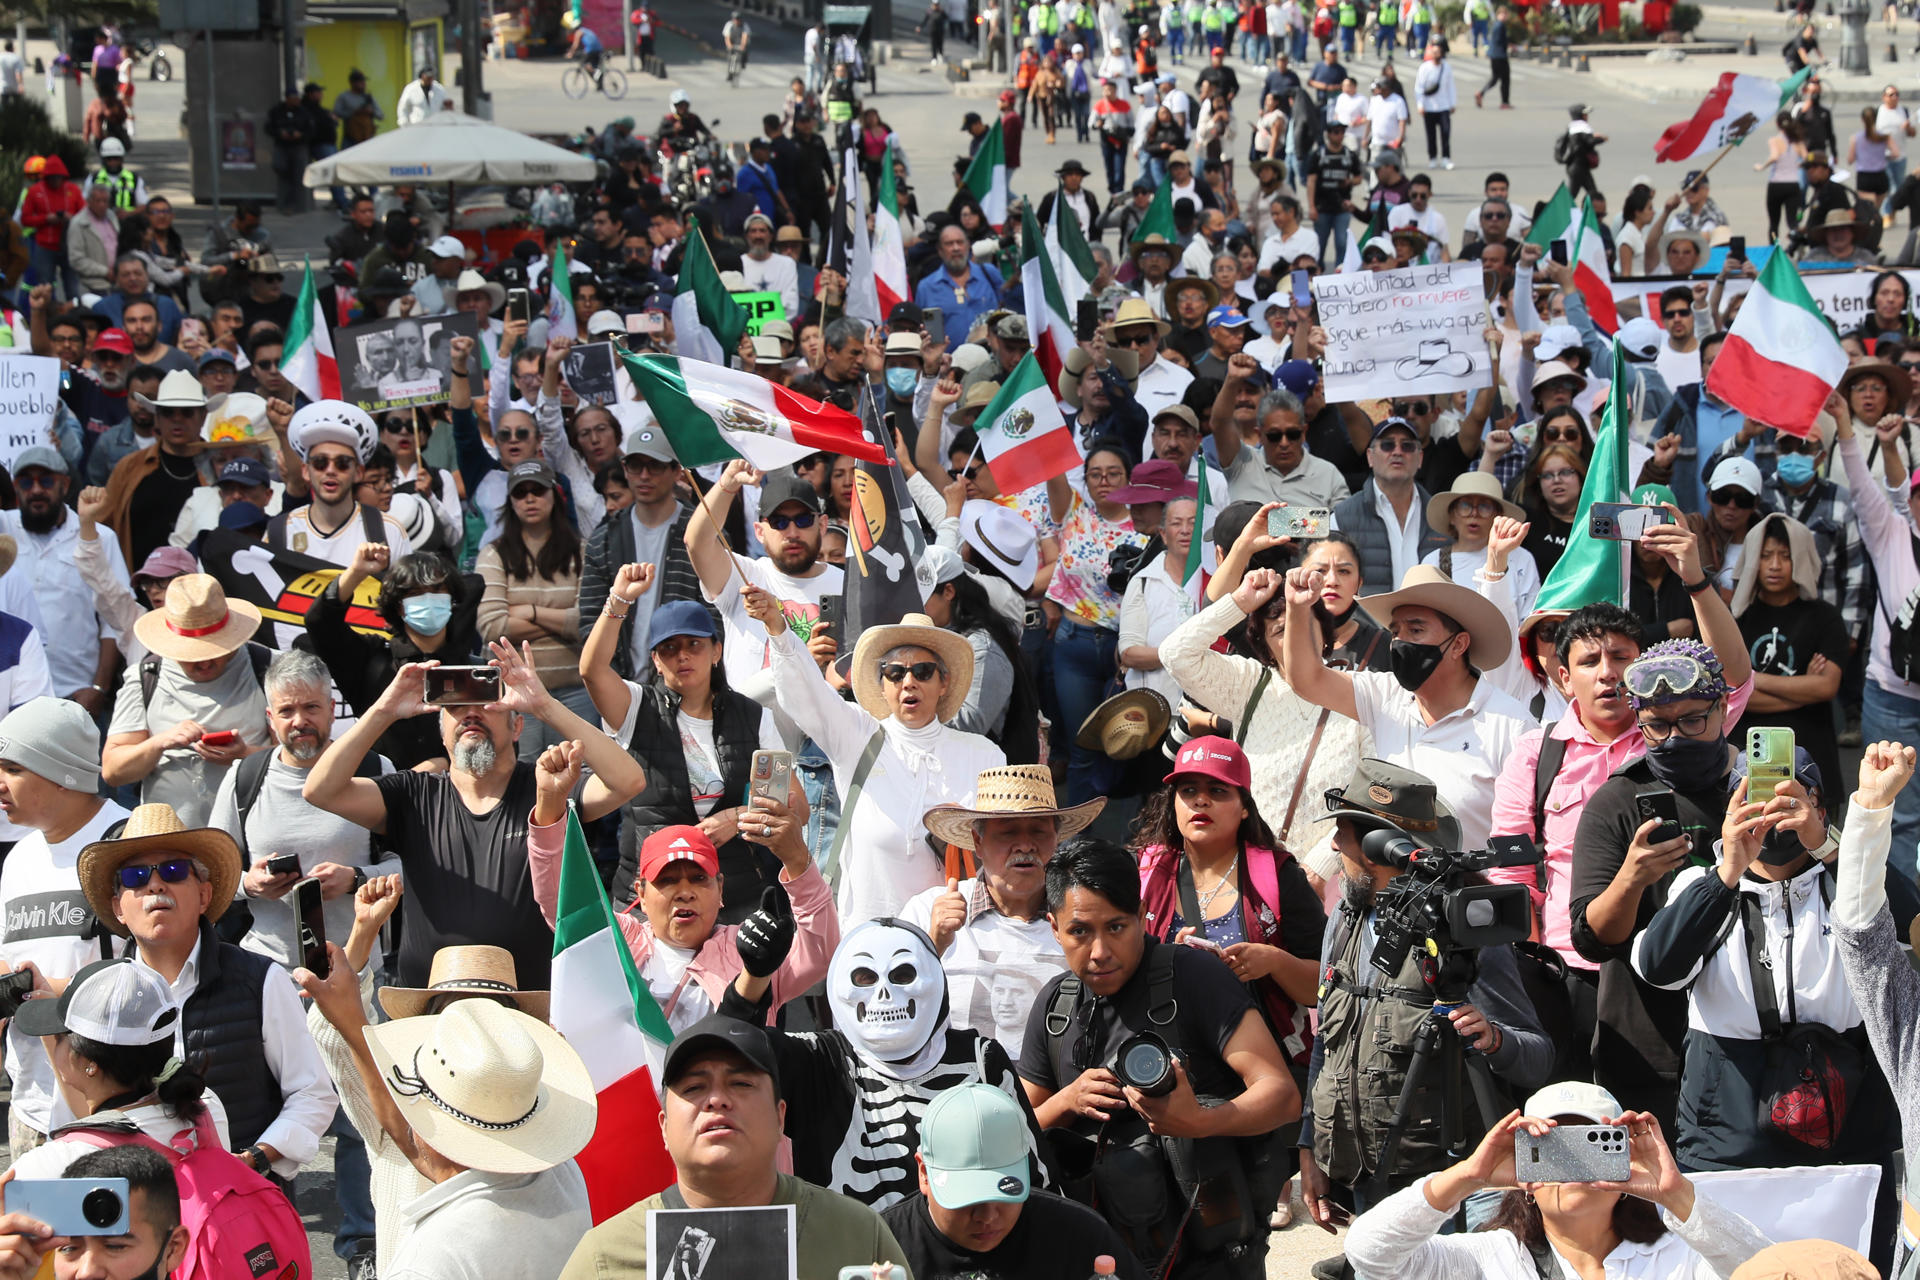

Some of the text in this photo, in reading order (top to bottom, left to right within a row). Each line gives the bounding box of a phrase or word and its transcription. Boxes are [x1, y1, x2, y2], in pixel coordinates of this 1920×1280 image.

[1316, 265, 1453, 300] La voluntad del
[1392, 296, 1414, 308] no
[1418, 289, 1471, 304] muere
[1377, 319, 1413, 335] más
[1420, 317, 1454, 331] viva
[1457, 311, 1486, 336] que
[1325, 359, 1376, 377] nunca
[9, 429, 36, 447] mi
